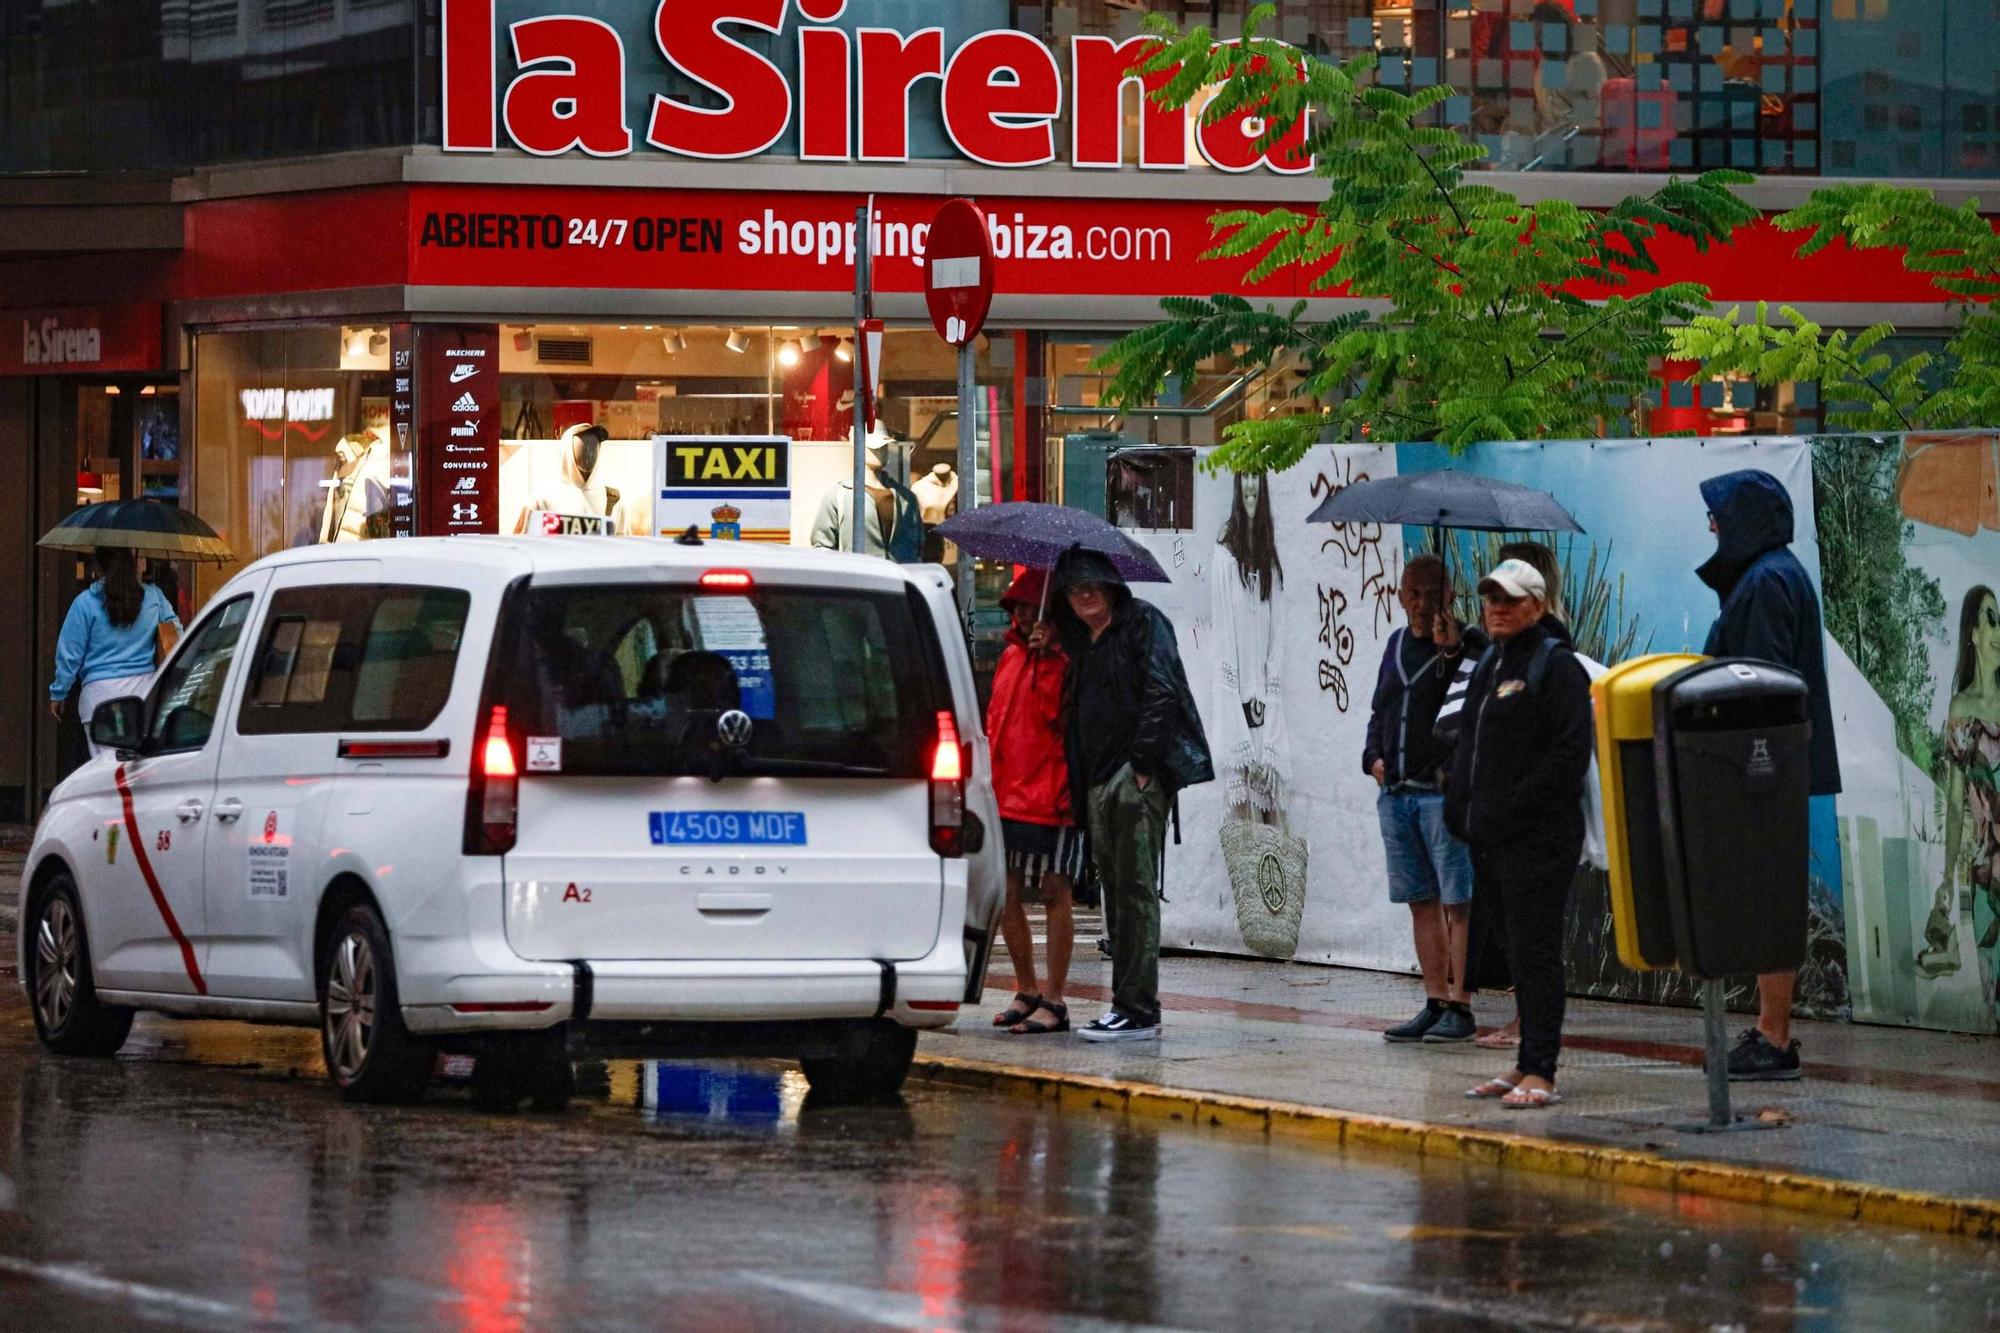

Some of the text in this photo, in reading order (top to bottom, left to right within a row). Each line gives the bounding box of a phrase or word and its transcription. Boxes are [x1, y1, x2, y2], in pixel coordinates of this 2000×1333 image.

[420, 208, 1171, 267] ABIERTO 24/7 OPEN shoppingbiza.com
[395, 350, 410, 367] EA7
[446, 349, 486, 357] SKECHERS
[454, 364, 475, 375] NIKE
[451, 404, 480, 412] adidas
[451, 427, 475, 436] PUMA
[443, 461, 481, 469] CONVERSE
[675, 447, 776, 480] TAXI
[669, 814, 740, 840] 4509
[749, 815, 798, 840] MDF
[157, 830, 171, 851] 58
[679, 865, 788, 875] CADDY
